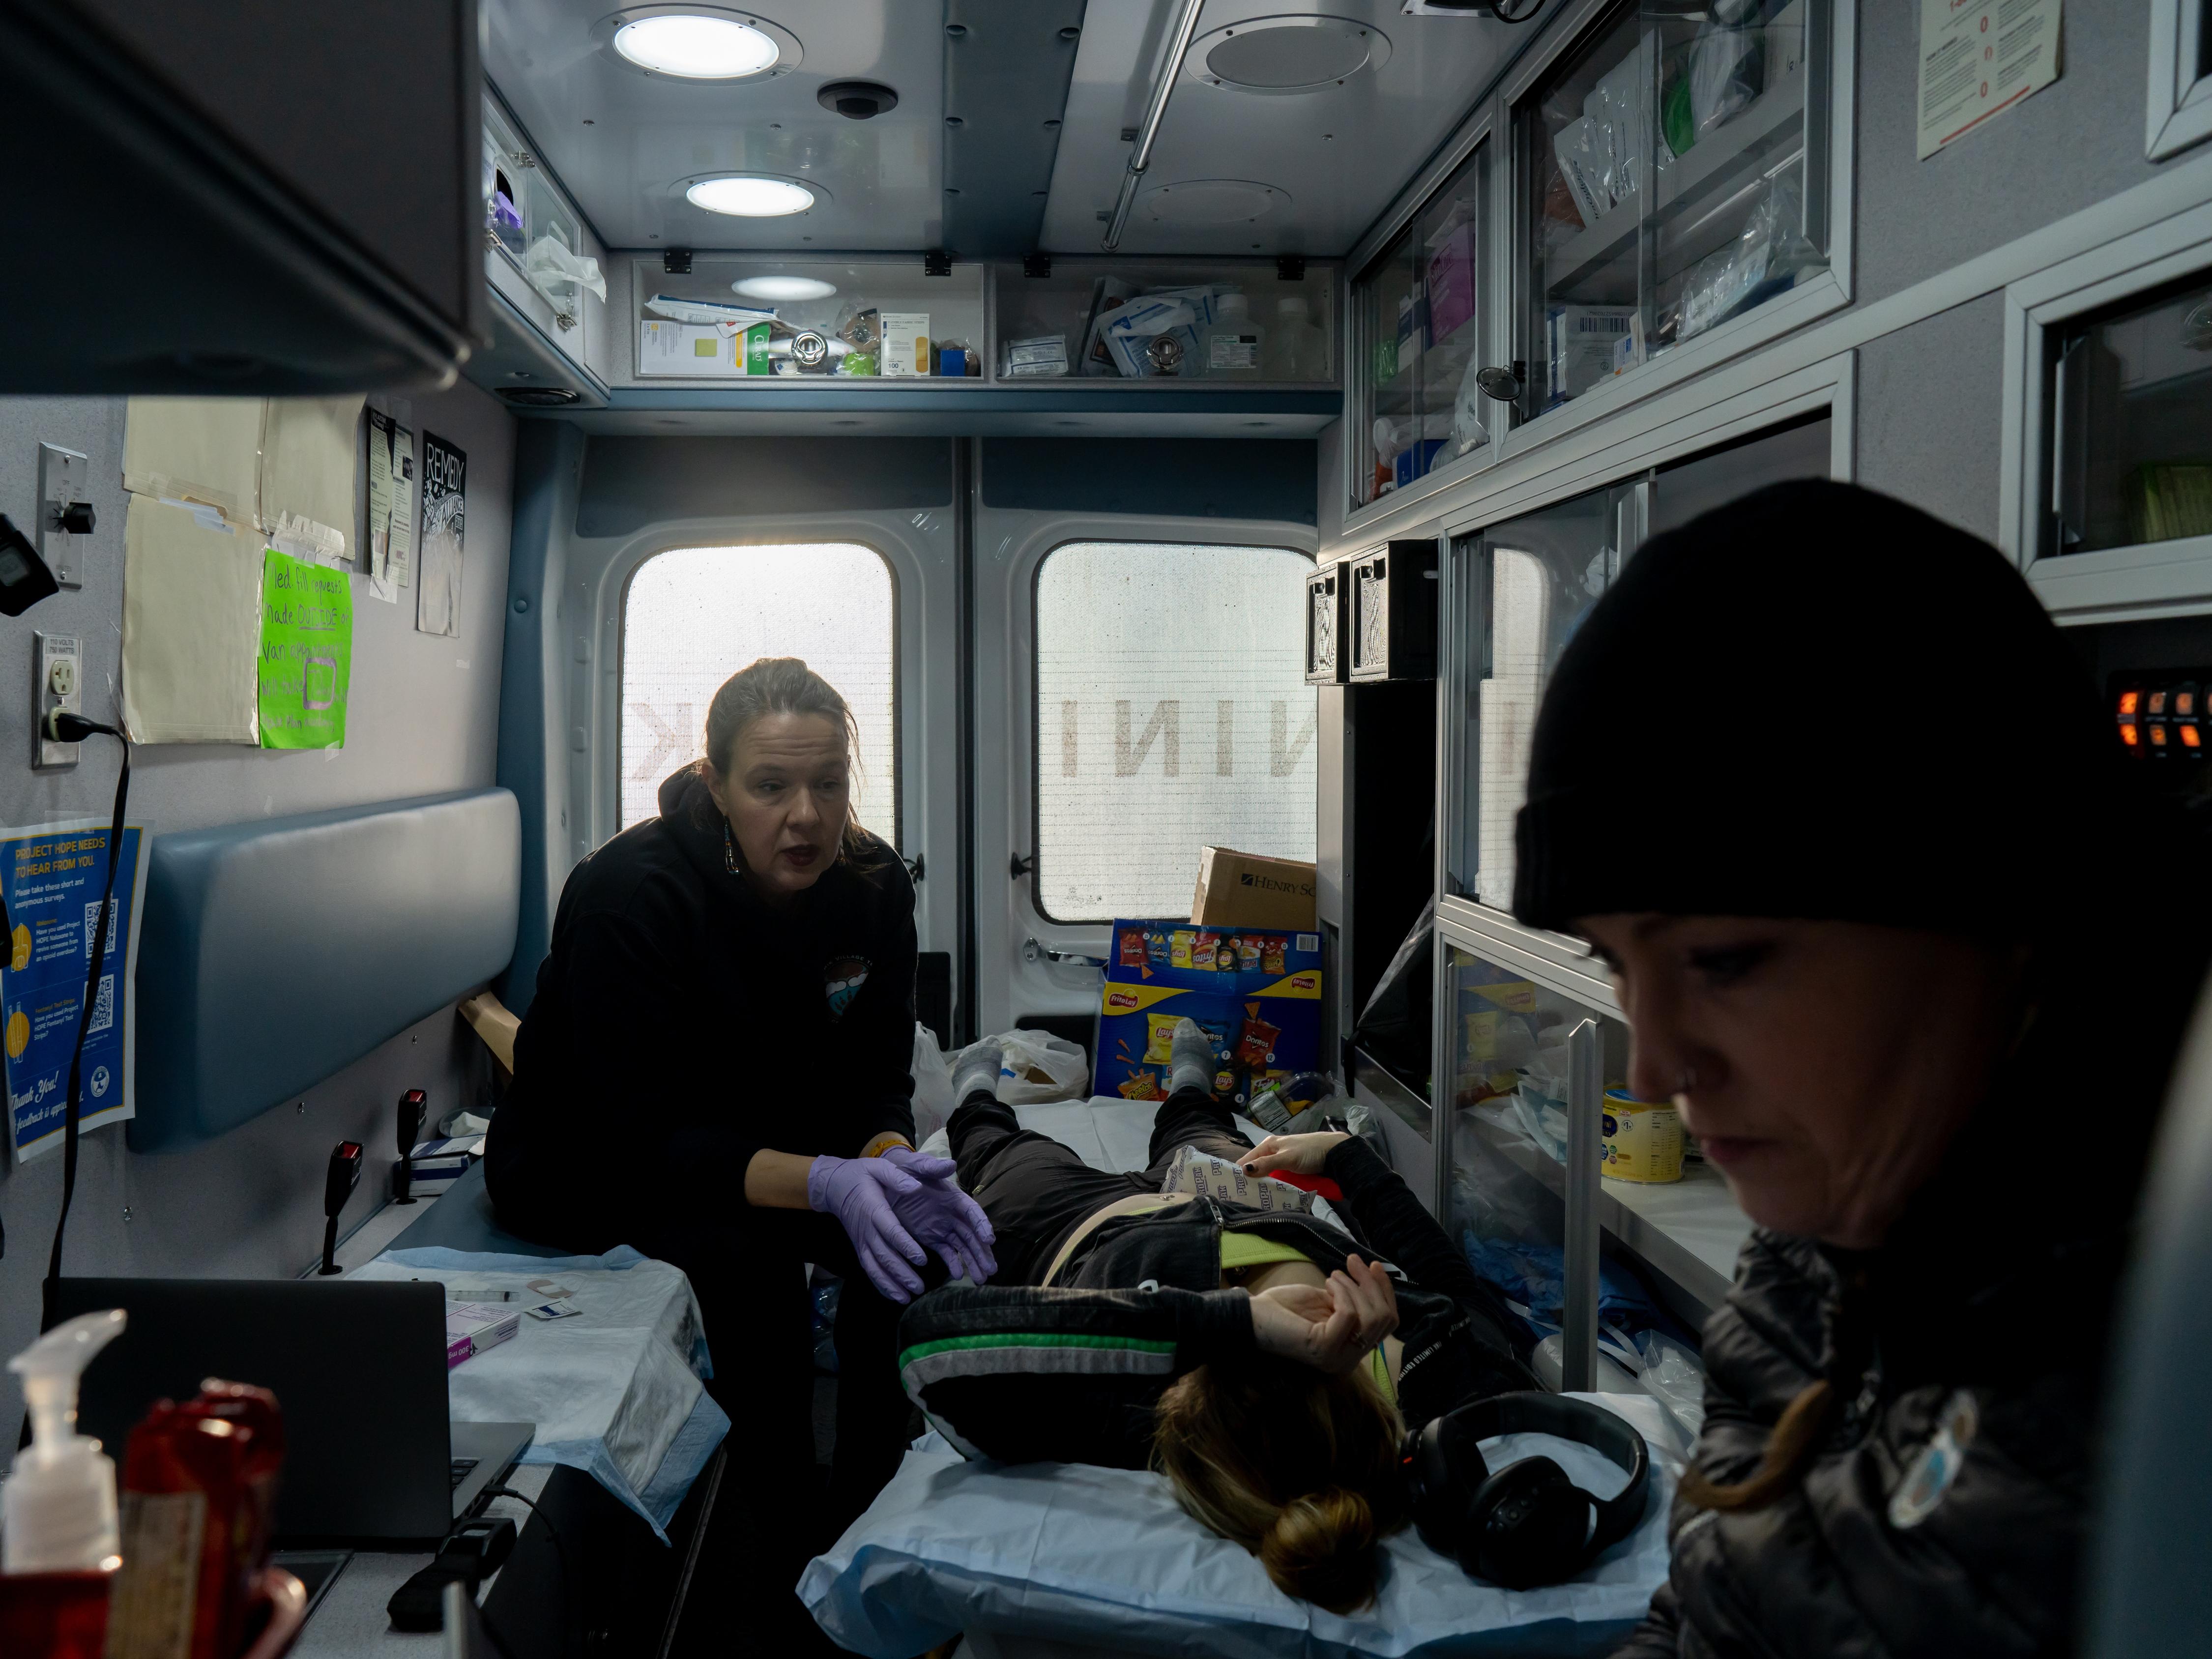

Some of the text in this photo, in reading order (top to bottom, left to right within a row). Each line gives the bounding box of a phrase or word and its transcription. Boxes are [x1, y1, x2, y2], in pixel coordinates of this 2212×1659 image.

[427, 442, 465, 492] REMEDY
[311, 579, 343, 606] requests
[297, 604, 338, 627] OUTSIDE
[15, 837, 106, 861] PROJECT HOPE NEEDS
[15, 855, 95, 879] TO HEAR FROM YOU.
[15, 877, 85, 898] Please take these short and
[1254, 875, 1299, 893] HENRY
[15, 894, 65, 909] anonymous surveys.
[66, 921, 81, 929] Project
[42, 951, 56, 961] opioid
[56, 946, 77, 957] overdose?
[1193, 950, 1214, 964] Fritos
[54, 1008, 64, 1017] used
[64, 1004, 79, 1014] Project
[34, 1022, 46, 1032] HOPE
[47, 1016, 64, 1027] Fentanyl
[34, 1030, 49, 1041] Strips?
[1246, 1034, 1269, 1048] Doritos
[35, 1070, 59, 1104] You!
[16, 1107, 44, 1135] feedback
[44, 1106, 50, 1119] is
[1193, 1166, 1206, 1195] ROPAK
[1258, 1182, 1271, 1210] ROPAK
[458, 1345, 469, 1356] 300
[1413, 1346, 1435, 1364] LIMITED
